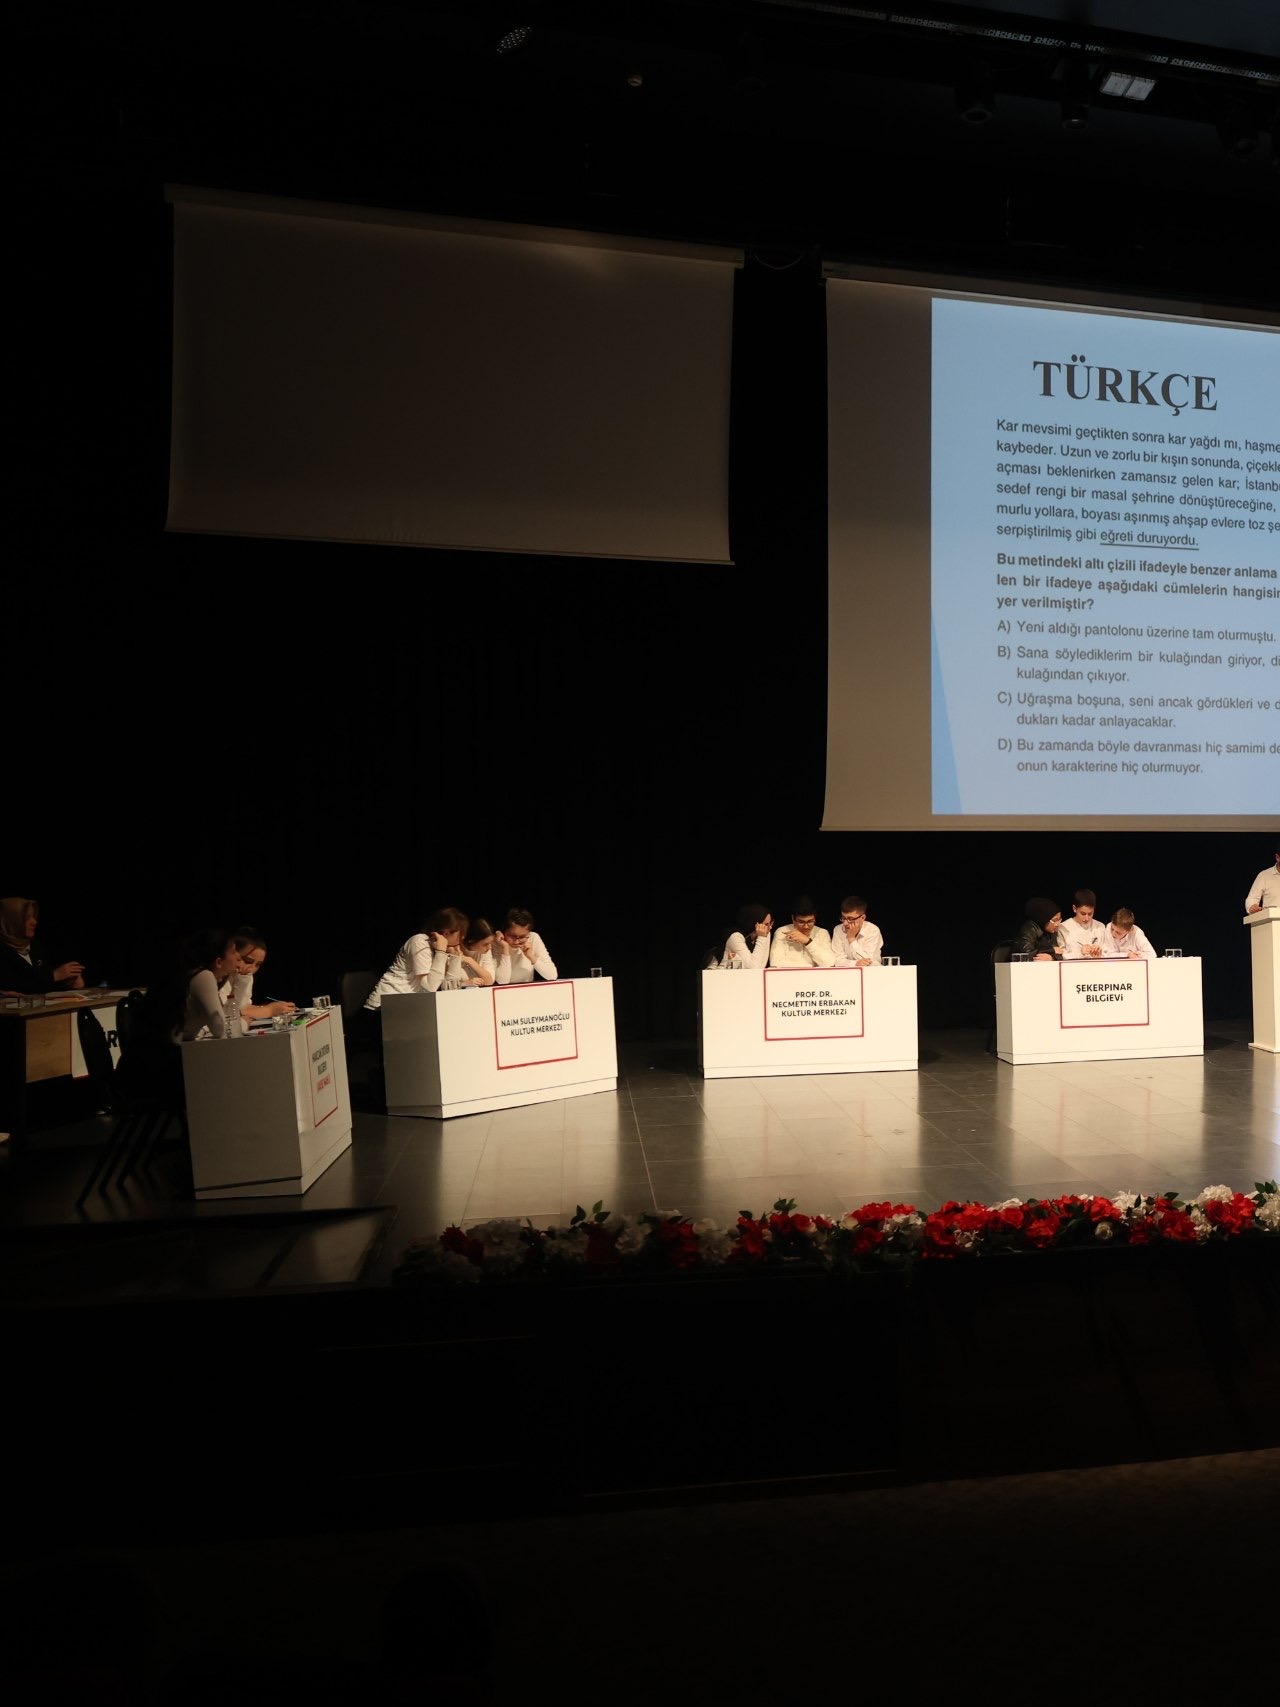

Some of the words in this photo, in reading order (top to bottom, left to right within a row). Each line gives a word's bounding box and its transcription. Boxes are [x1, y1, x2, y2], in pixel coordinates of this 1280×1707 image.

[1033, 354, 1217, 416] TÜRKÇE
[997, 419, 1019, 432] Kar
[1022, 423, 1071, 436] mevsimi
[1076, 427, 1129, 441] geçtikten
[1132, 432, 1165, 444] sonra
[1168, 433, 1186, 445] kar
[1190, 435, 1220, 450] yağdı
[1224, 440, 1241, 451] mı,
[997, 440, 1056, 455] kaybeder.
[1060, 444, 1091, 458] Uzun
[1095, 450, 1109, 459] ve
[1112, 450, 1140, 462] zorlu
[1143, 451, 1158, 463] bir
[1161, 452, 1188, 467] kışın
[1191, 457, 1243, 471] sonunda,
[997, 463, 1041, 476] açması
[1047, 464, 1116, 480] beklenirken
[1121, 472, 1177, 485] zamansız
[1182, 474, 1213, 488] gelen
[1219, 476, 1240, 490] kar;
[996, 482, 1031, 495] sedef
[1036, 486, 1066, 500] rengi
[1071, 486, 1087, 498] bir
[1091, 490, 1127, 501] masal
[1132, 491, 1175, 505] şehrine
[1179, 494, 1276, 513] dönüştüreceğine,
[997, 504, 1031, 516] murlu
[1034, 505, 1078, 520] yollara,
[1081, 507, 1120, 523] boyası
[1123, 512, 1170, 527] aşınmış
[1172, 513, 1208, 528] ahşap
[1211, 516, 1245, 529] evlere
[1248, 518, 1265, 530] toz
[996, 524, 1072, 541] serpiştirilmiş
[1076, 528, 1096, 542] gibi
[1101, 529, 1133, 545] eğreti
[1137, 531, 1199, 547] duruyordu.
[997, 553, 1015, 565] Bu
[1018, 555, 1081, 568] metindeki
[1085, 558, 1104, 570] altı
[1107, 558, 1136, 573] çizili
[1140, 560, 1187, 576] ifadeyle
[1190, 563, 1231, 576] benzer
[1234, 566, 1277, 579] anlama
[997, 573, 1017, 586] len
[1023, 575, 1041, 587] bir
[1046, 576, 1092, 592] ifadeye
[1098, 579, 1158, 594] aşağıdaki
[1163, 582, 1227, 596] cümlelerin
[996, 597, 1018, 609] yer
[1021, 596, 1094, 612] verilmiştir?
[997, 620, 1011, 634] A)
[1017, 620, 1044, 633] Yeni
[1048, 622, 1080, 637] aldığı
[1085, 625, 1143, 637] pantolonu
[1147, 626, 1189, 639] üzerine
[1192, 629, 1214, 640] tam
[1218, 630, 1276, 644] oturmuştu.
[998, 646, 1011, 660] B)
[1017, 646, 1049, 659] Sana
[1055, 648, 1132, 662] söylediklerim
[1138, 650, 1153, 662] bir
[1159, 651, 1222, 666] kulağından
[1228, 654, 1265, 668] giriyor,
[1017, 667, 1083, 683] kulağından
[1087, 669, 1129, 684] çıkıyor.
[997, 691, 1012, 706] C)
[1017, 692, 1072, 707] Uğraşma
[1077, 693, 1124, 709] boşuna,
[1129, 696, 1153, 707] seni
[1158, 697, 1193, 710] ancak
[1197, 697, 1253, 712] gördükleri
[1257, 700, 1270, 710] ve
[1017, 713, 1058, 725] dukları
[1062, 714, 1096, 726] kadar
[1099, 715, 1176, 730] anlayacaklar.
[998, 738, 1012, 752] D)
[1017, 739, 1034, 750] Bu
[1039, 740, 1094, 751] zamanda
[1098, 740, 1130, 754] böyle
[1133, 741, 1201, 753] davranması
[1206, 742, 1222, 756] hiç
[1226, 743, 1265, 753] samimi
[1017, 762, 1047, 771] onun
[1052, 760, 1118, 772] karakterine
[1122, 761, 1138, 775] hiç
[1142, 762, 1203, 775] oturmuyor.
[1076, 983, 1133, 994] ŞEKERPINAR
[1086, 994, 1123, 1003] BİLGİEVİ
[772, 1000, 817, 1008] NECMETTİN
[819, 999, 856, 1007] ERBAKAN
